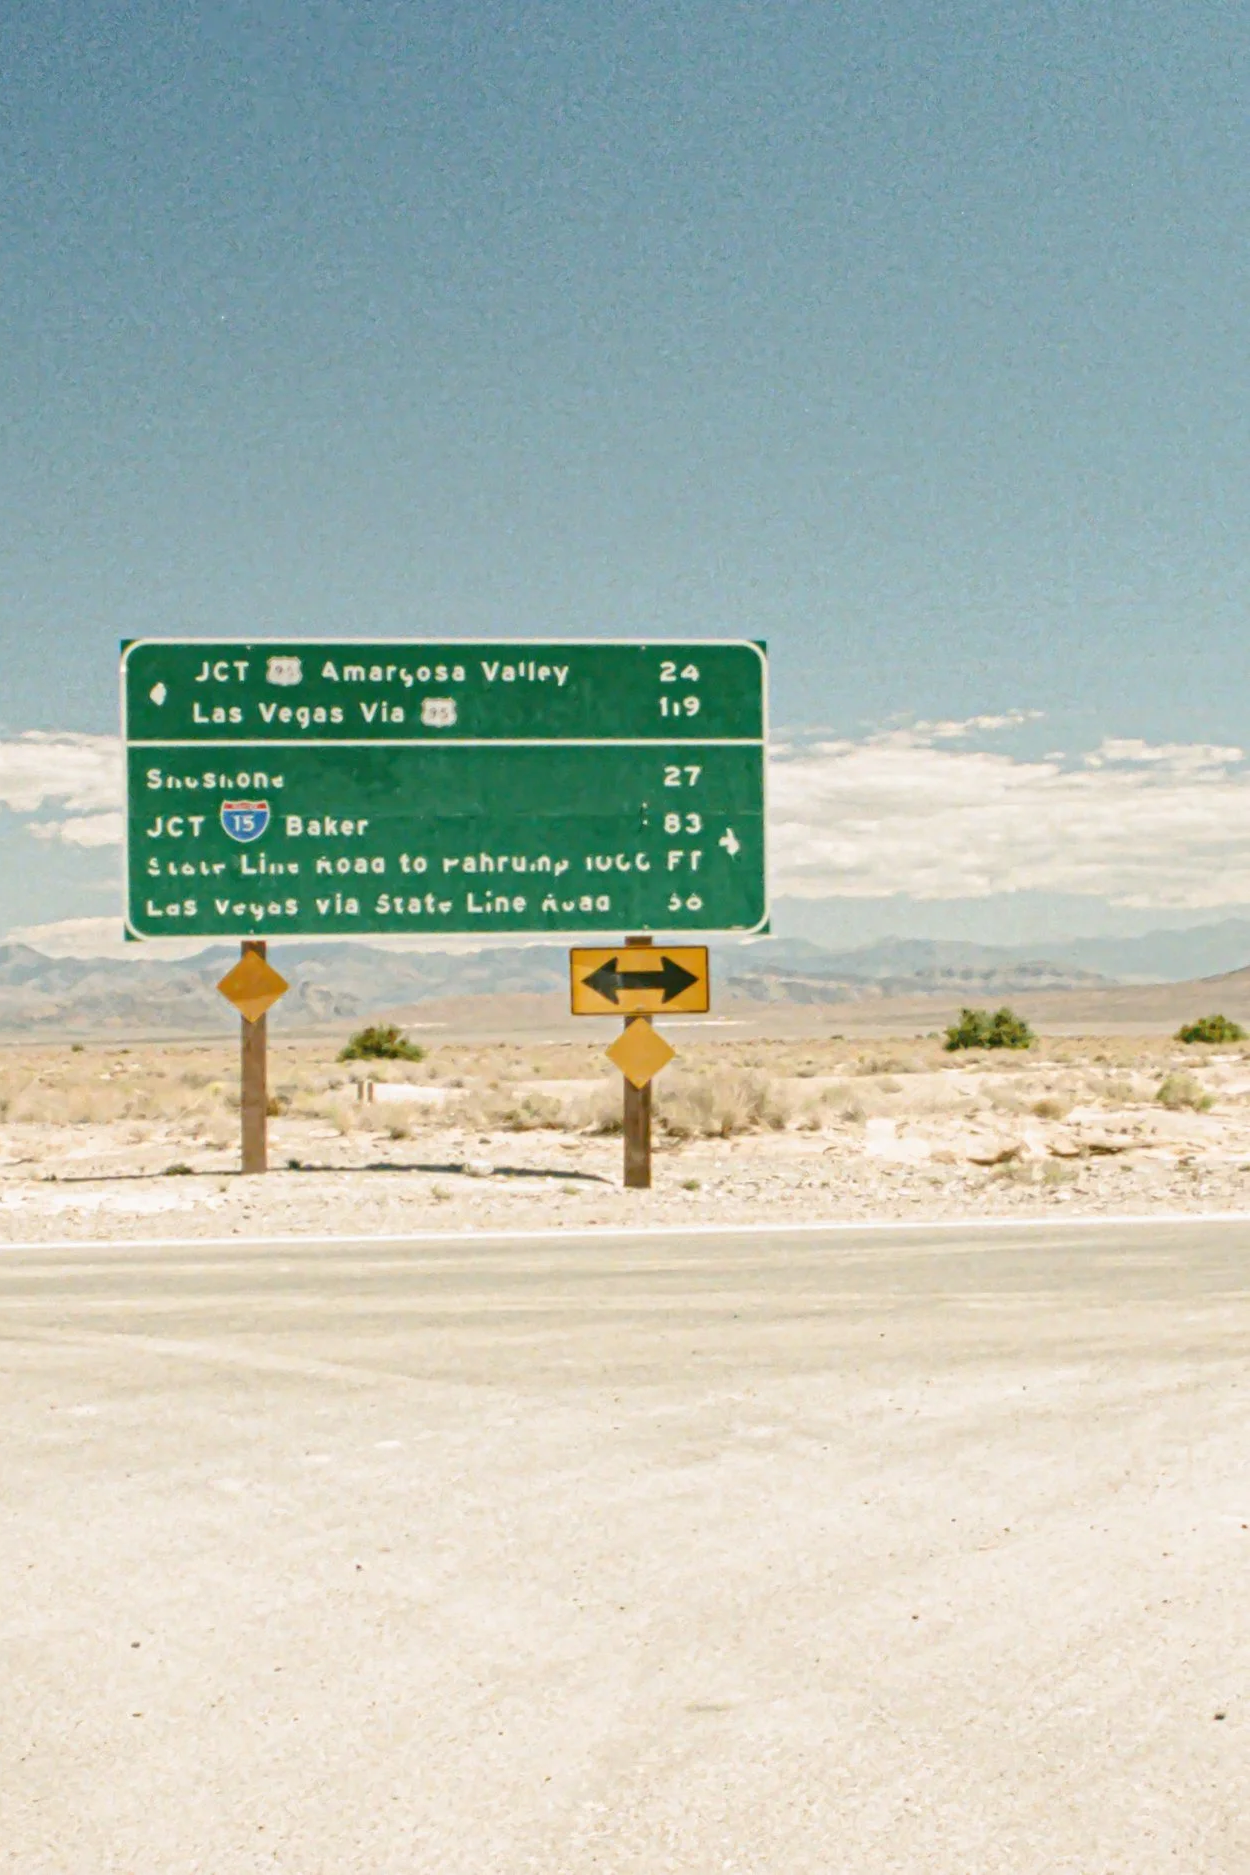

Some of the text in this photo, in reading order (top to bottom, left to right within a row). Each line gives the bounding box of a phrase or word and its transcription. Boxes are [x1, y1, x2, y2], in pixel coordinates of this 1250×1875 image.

[195, 661, 249, 681] JCT
[321, 661, 466, 688] Amargosa
[481, 661, 569, 687] Valley
[660, 662, 700, 682] 24
[192, 702, 243, 723] Las
[258, 702, 344, 729] Vegas
[359, 701, 405, 723] Via
[659, 696, 701, 717] 119
[663, 766, 702, 787] 27
[146, 812, 703, 838] JCT 15 Baker 83
[398, 853, 428, 874] to
[146, 899, 198, 917] Las
[214, 898, 299, 922] Vegas
[374, 892, 453, 915] State
[466, 890, 527, 914] Line
